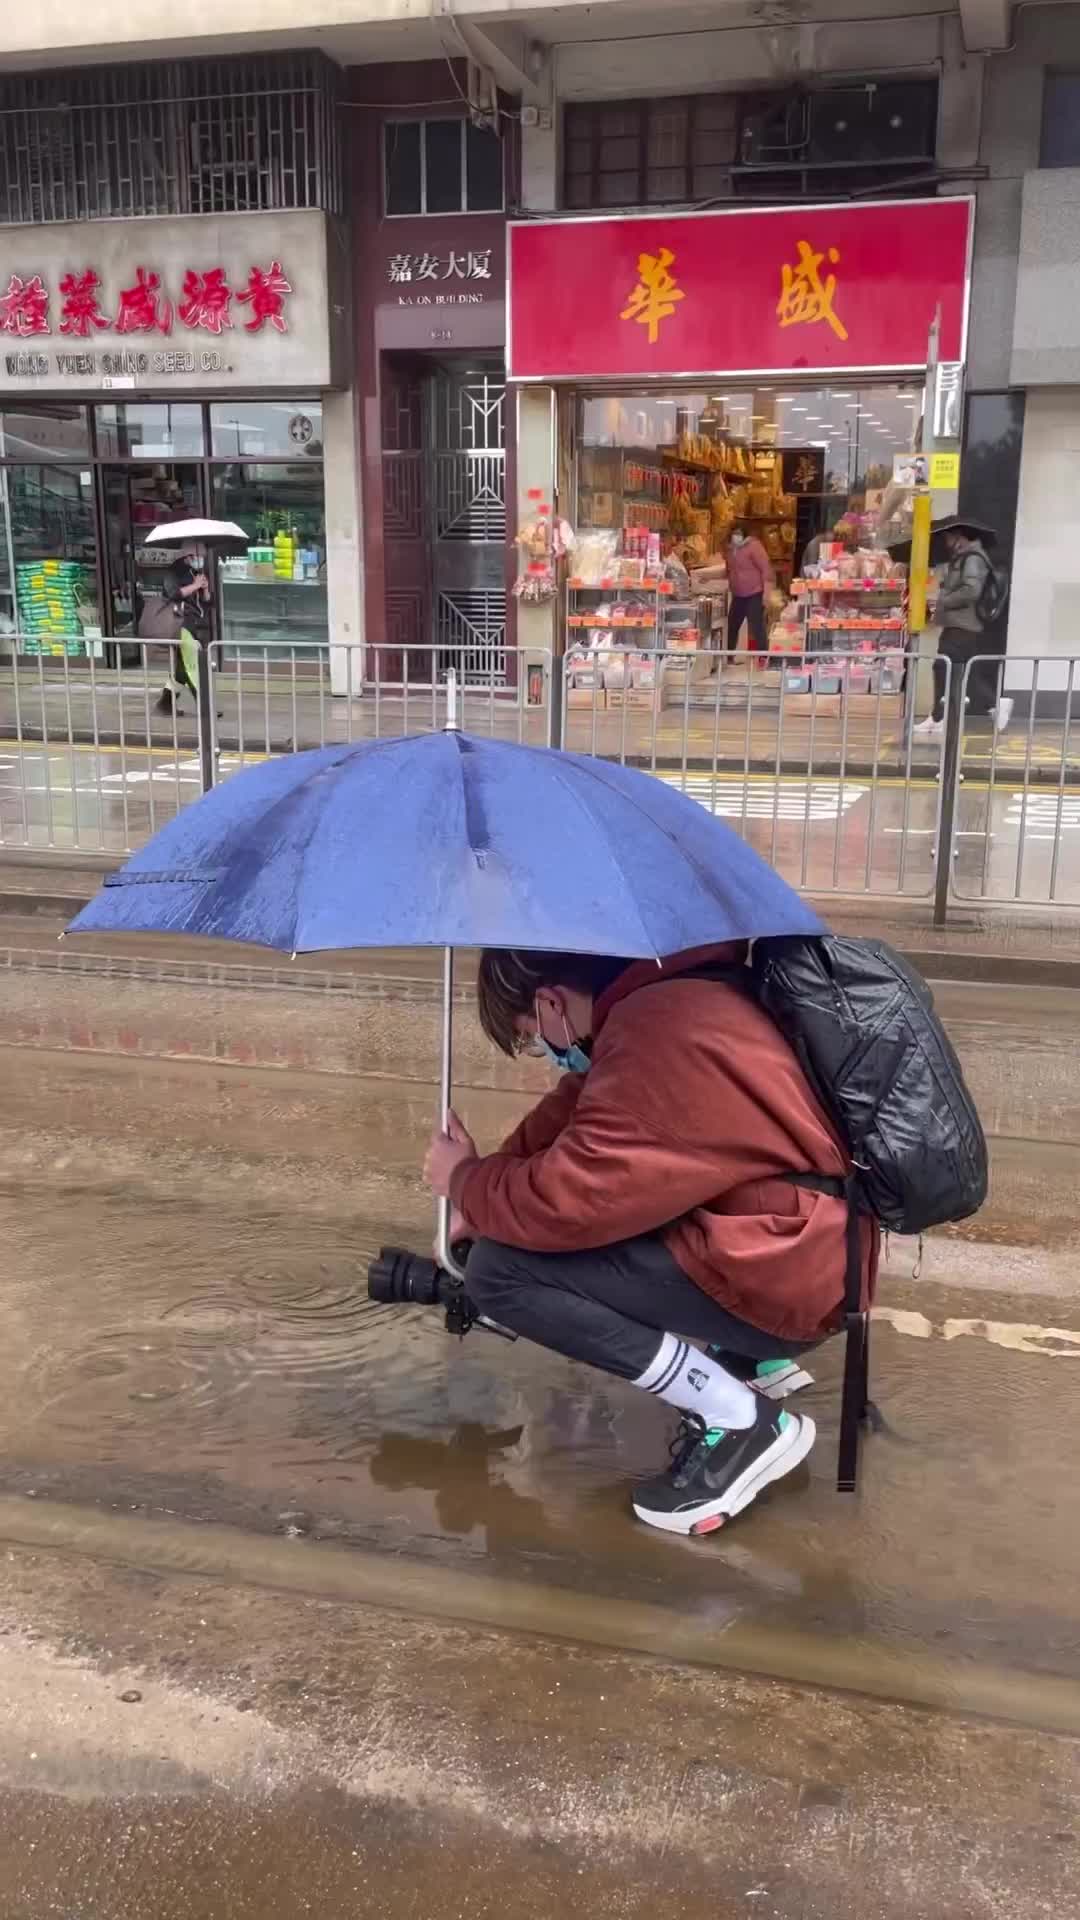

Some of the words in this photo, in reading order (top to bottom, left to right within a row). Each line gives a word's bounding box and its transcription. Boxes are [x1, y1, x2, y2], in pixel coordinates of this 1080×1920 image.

[399, 295, 413, 305] KA
[417, 295, 432, 305] ON
[436, 293, 483, 304] BUILDING
[5, 353, 49, 376] WONG
[56, 352, 96, 376] YUEN
[102, 350, 147, 375] SHING
[153, 350, 195, 373] SEED
